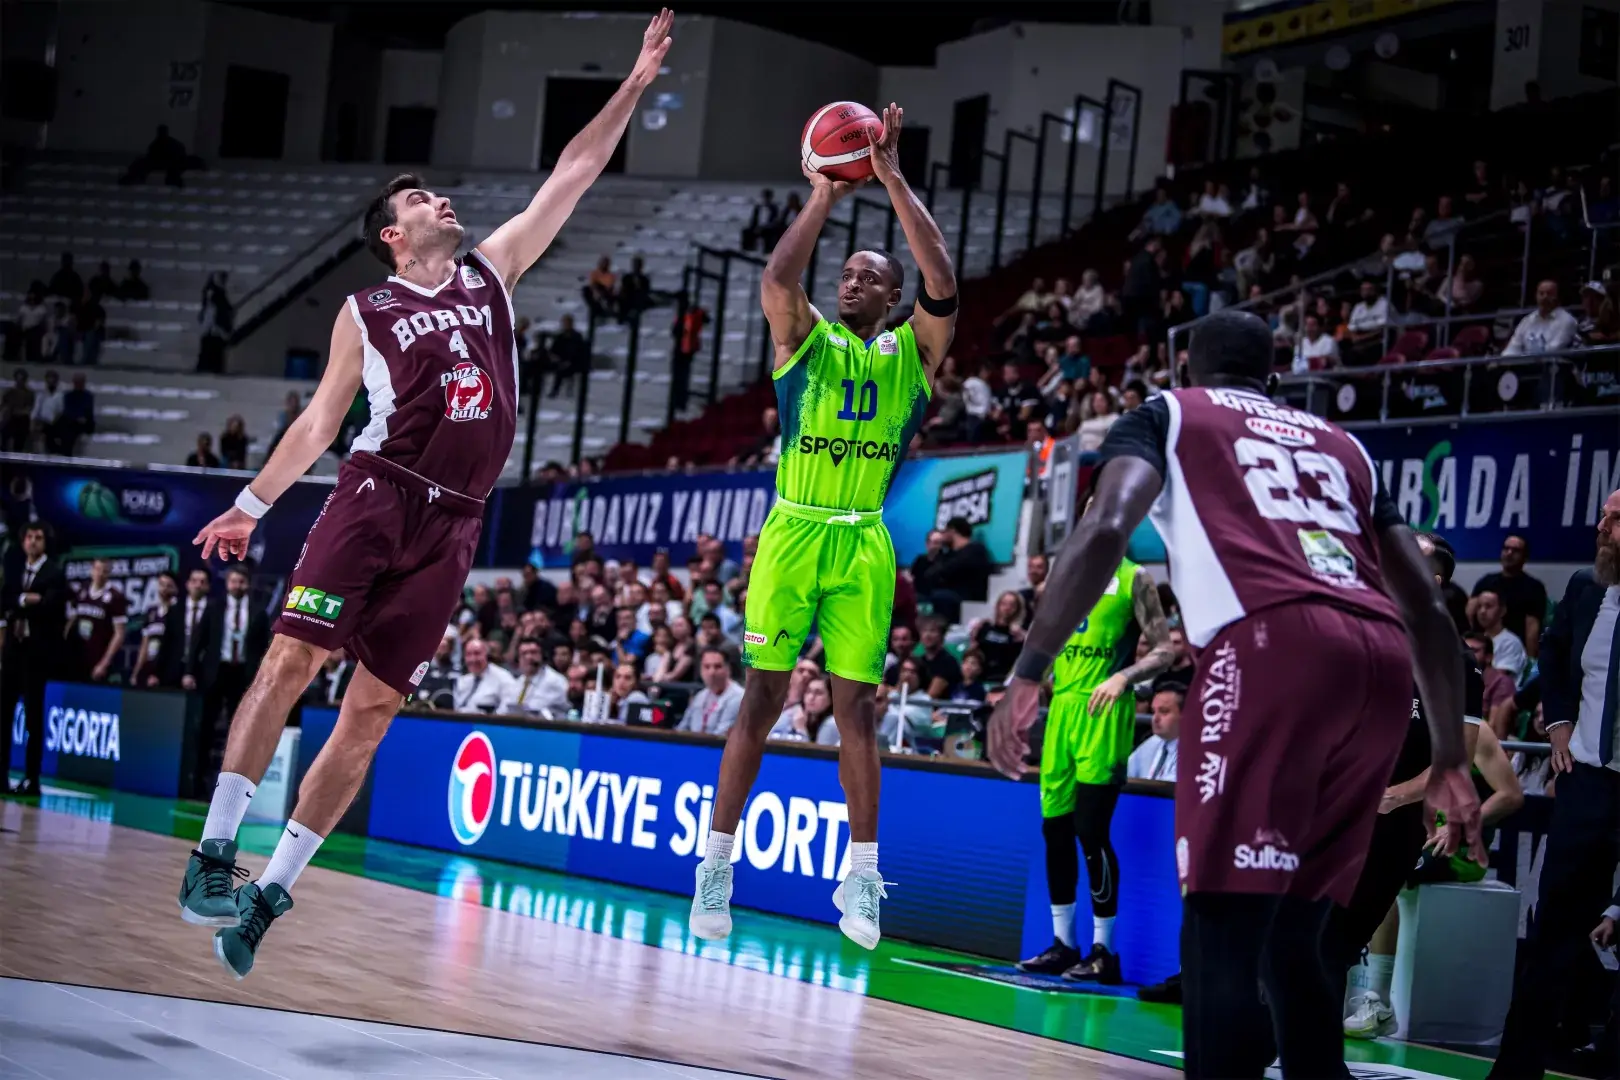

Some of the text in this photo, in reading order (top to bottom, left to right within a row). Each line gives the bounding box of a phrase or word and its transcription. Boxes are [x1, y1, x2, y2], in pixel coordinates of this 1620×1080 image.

[1504, 24, 1529, 52] 301
[391, 305, 493, 352] BORDO
[449, 330, 470, 359] 4
[440, 366, 481, 387] pizza
[450, 406, 489, 420] bulls
[837, 379, 878, 421] 10
[1234, 437, 1361, 535] 23
[1376, 440, 1530, 533] RSADA
[669, 489, 770, 543] YANIND
[287, 590, 342, 615] BKT
[302, 615, 335, 629] TOGETHER
[744, 634, 765, 644] astrol
[1200, 640, 1231, 743] ROYAL
